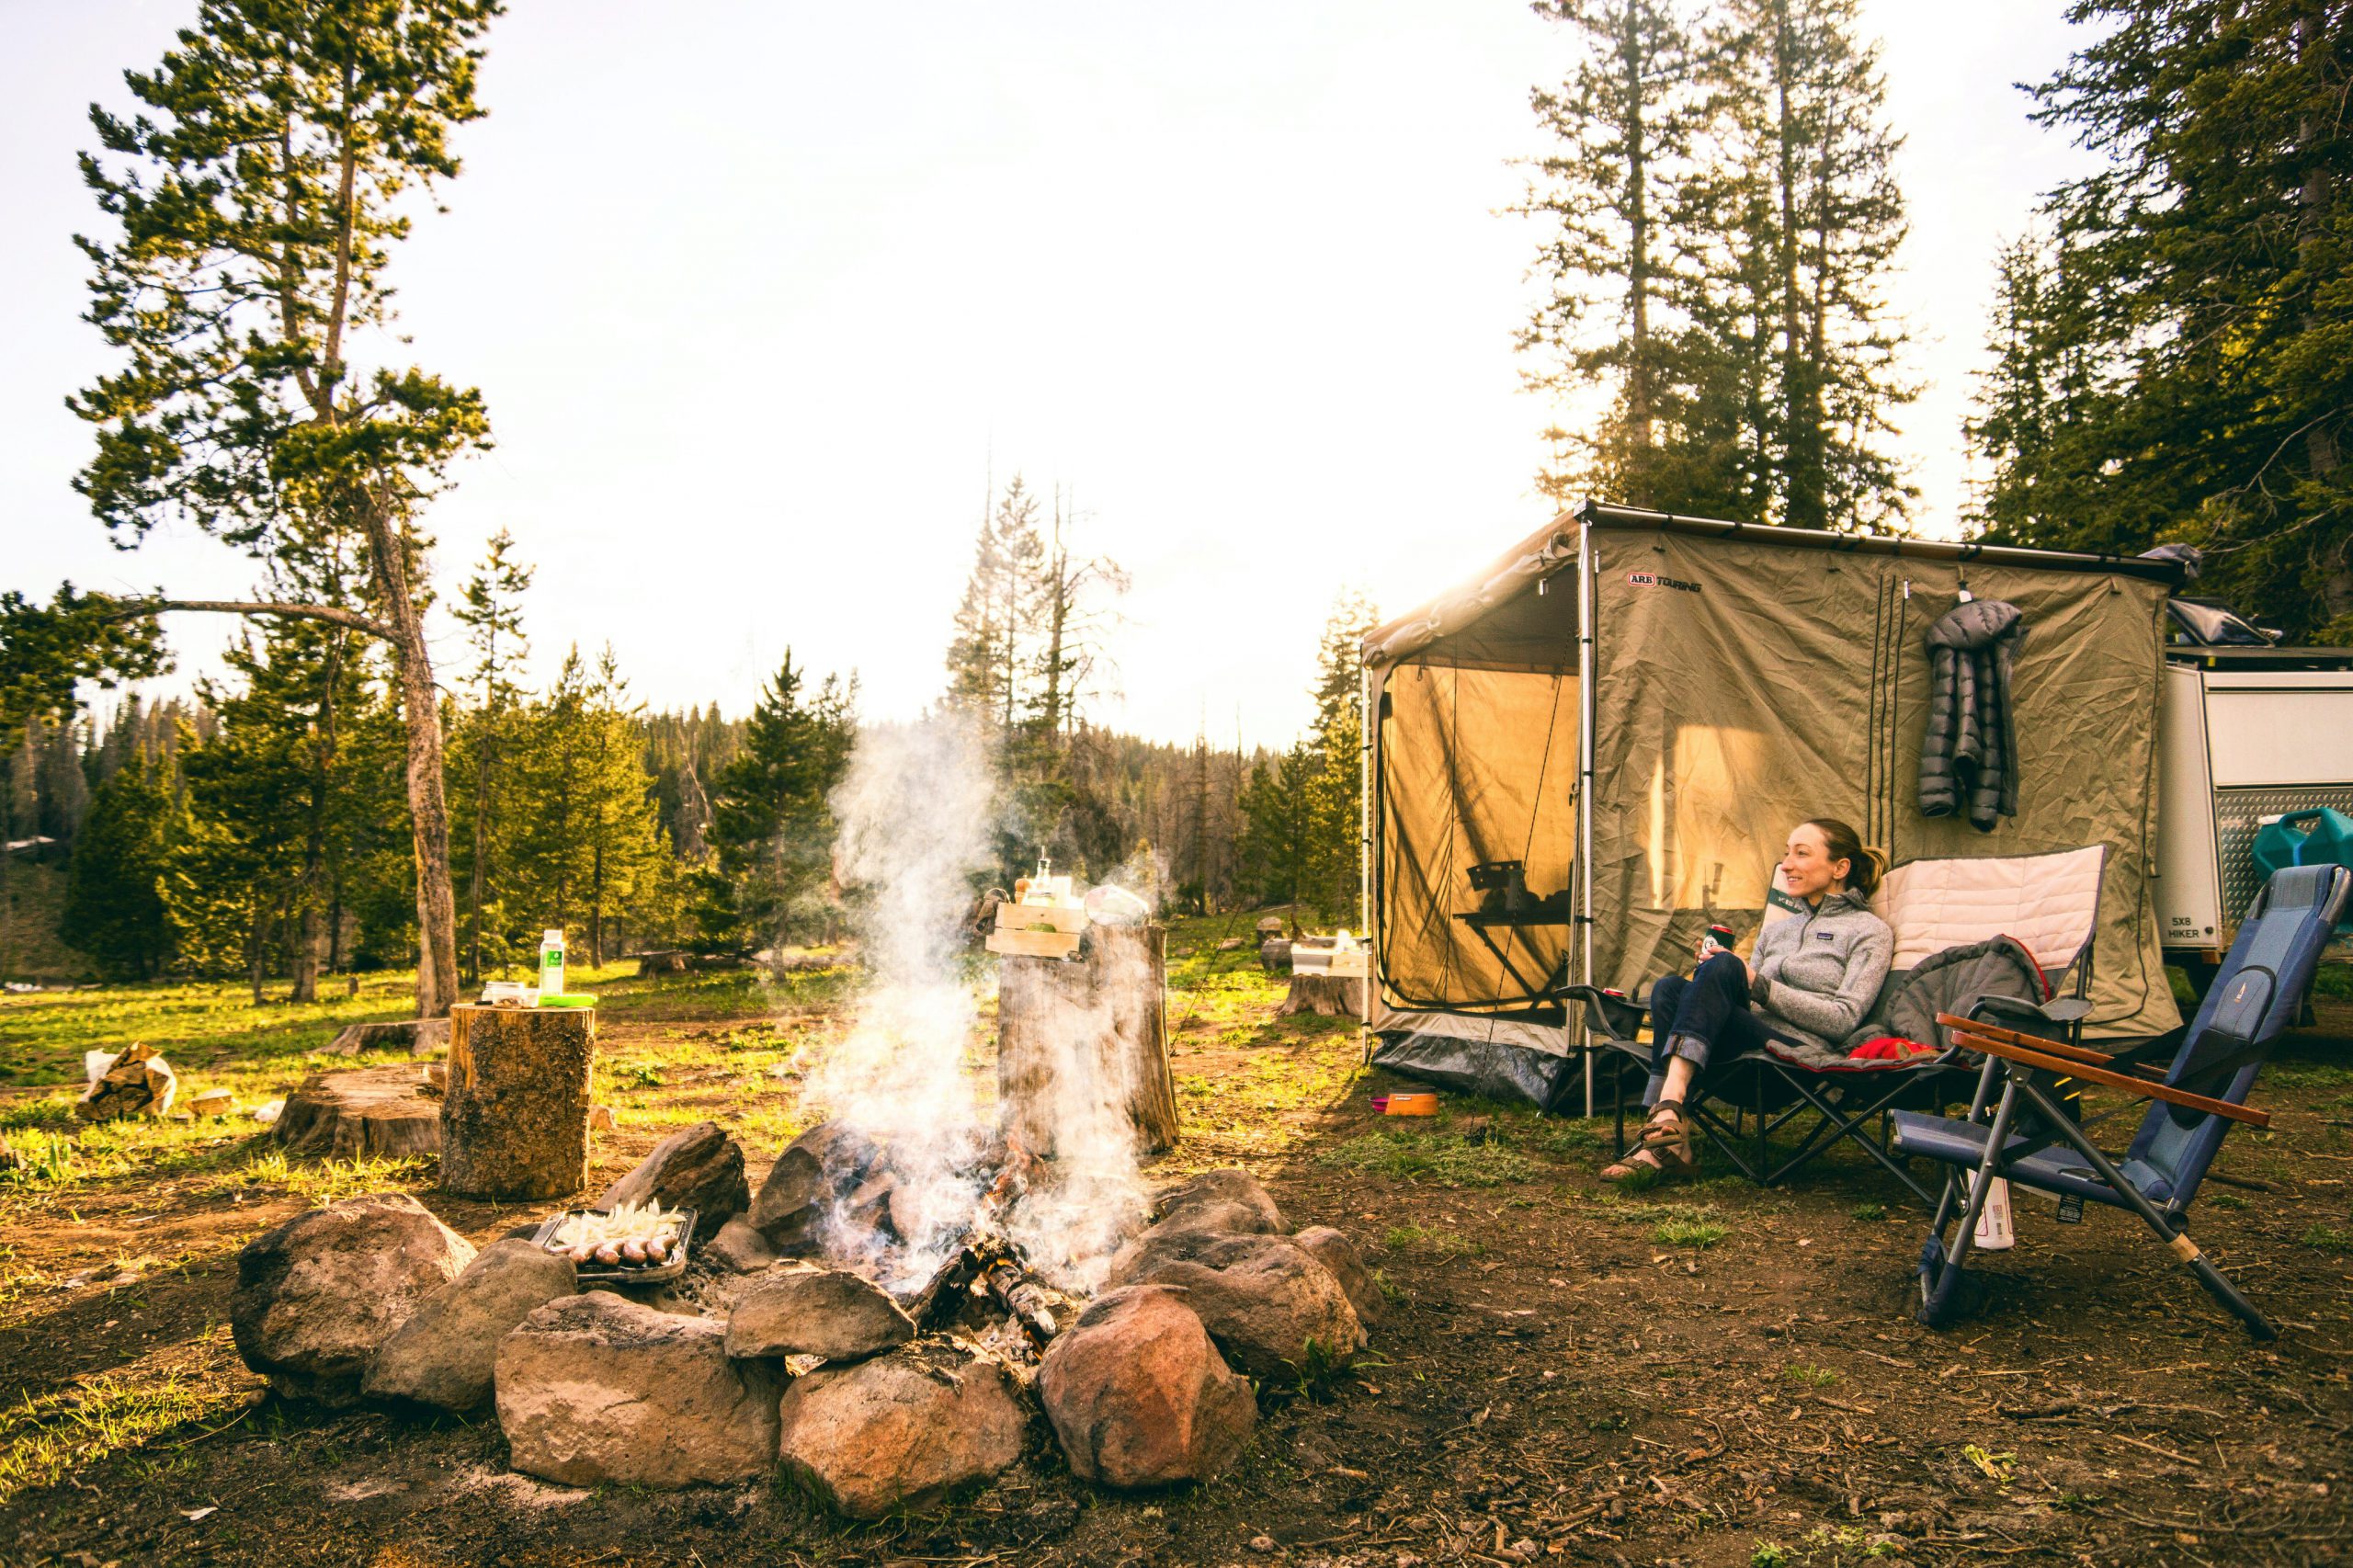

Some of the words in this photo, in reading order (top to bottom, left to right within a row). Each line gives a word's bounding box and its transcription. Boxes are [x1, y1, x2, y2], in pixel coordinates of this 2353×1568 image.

[1631, 575, 1653, 584] ARB
[1657, 576, 1702, 592] TOURING
[2172, 917, 2191, 926] 5X8
[2168, 929, 2200, 937] HIKER
